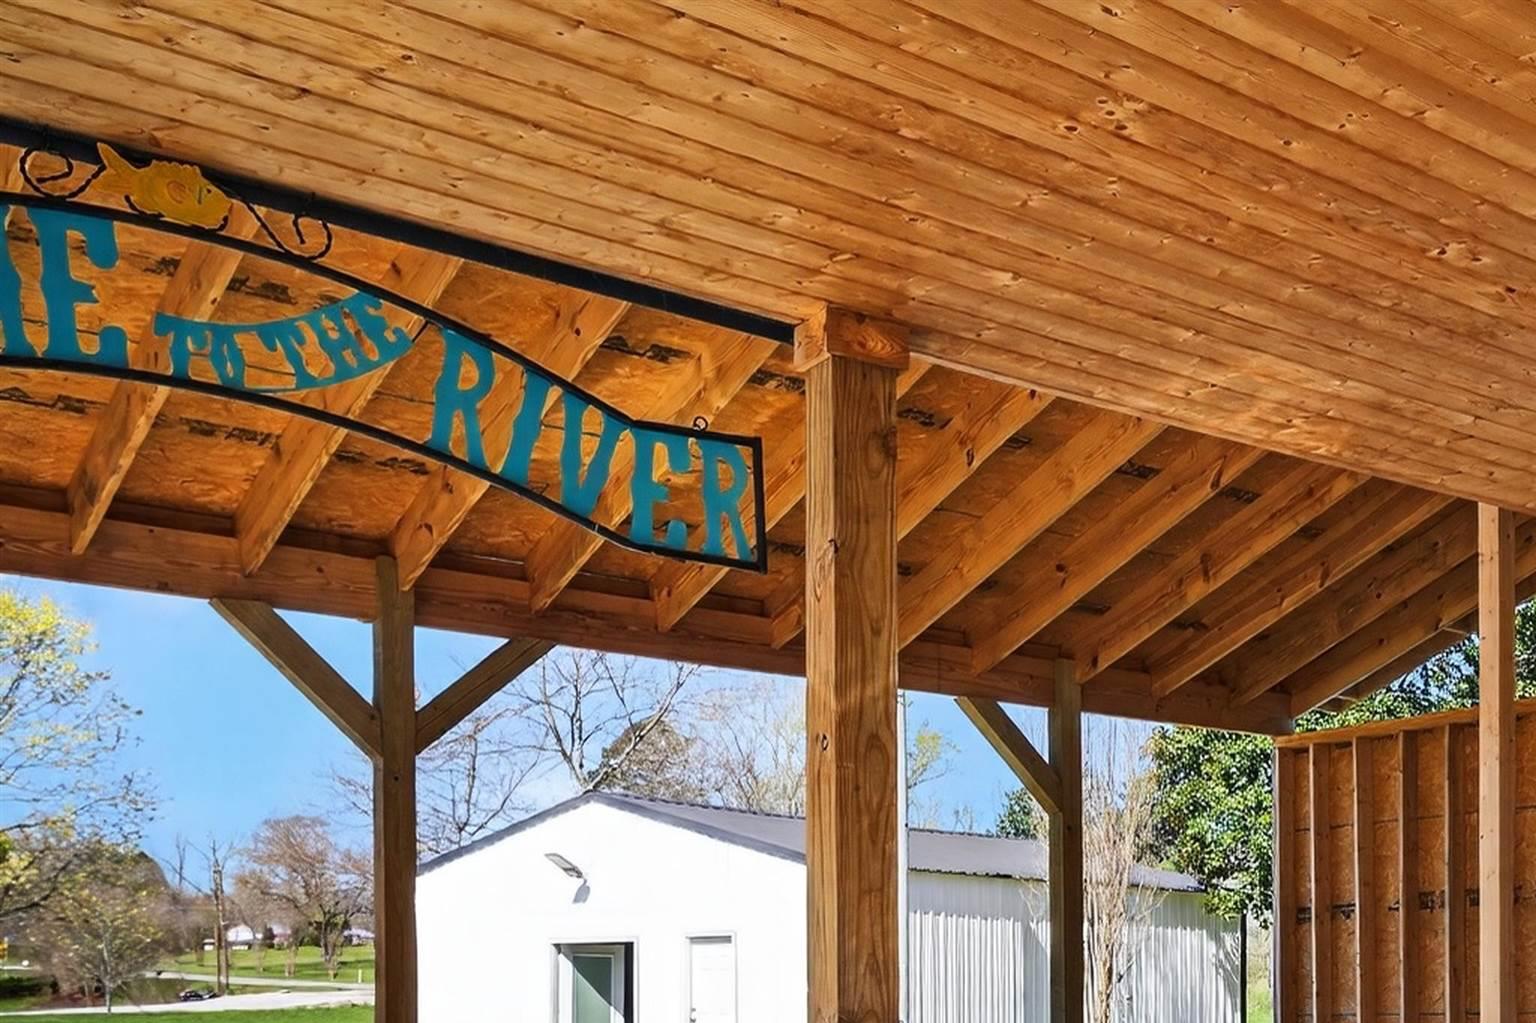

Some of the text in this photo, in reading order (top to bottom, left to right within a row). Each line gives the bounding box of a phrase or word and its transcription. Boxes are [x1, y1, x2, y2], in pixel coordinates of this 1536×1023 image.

[154, 312, 246, 387] TO
[254, 291, 415, 390] THE
[425, 327, 752, 561] RIVER
